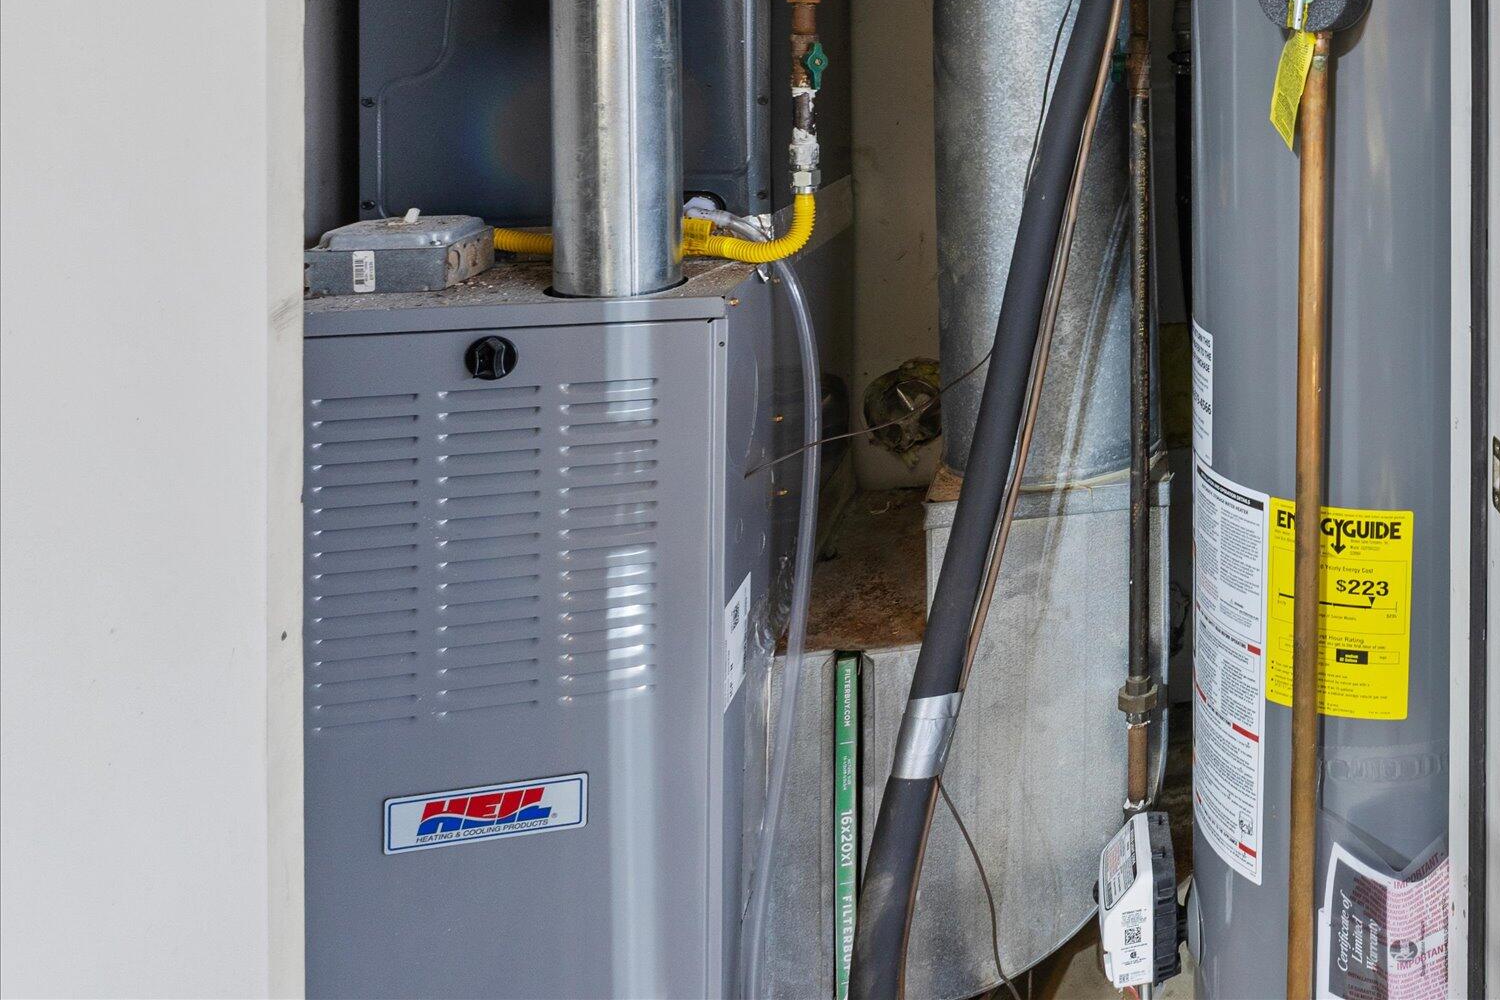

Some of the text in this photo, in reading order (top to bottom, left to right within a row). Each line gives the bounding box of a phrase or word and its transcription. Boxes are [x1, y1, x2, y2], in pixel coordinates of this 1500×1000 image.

[1336, 579, 1389, 596] $223
[416, 787, 552, 836] HEIL
[416, 830, 453, 844] HEATING
[463, 824, 501, 837] COOLING
[503, 819, 549, 831] PRODUCTS
[1394, 852, 1439, 889] IMPORTANT
[1337, 889, 1353, 972] Certificate of
[1350, 914, 1363, 963] Limited
[1366, 918, 1382, 972] Warranty
